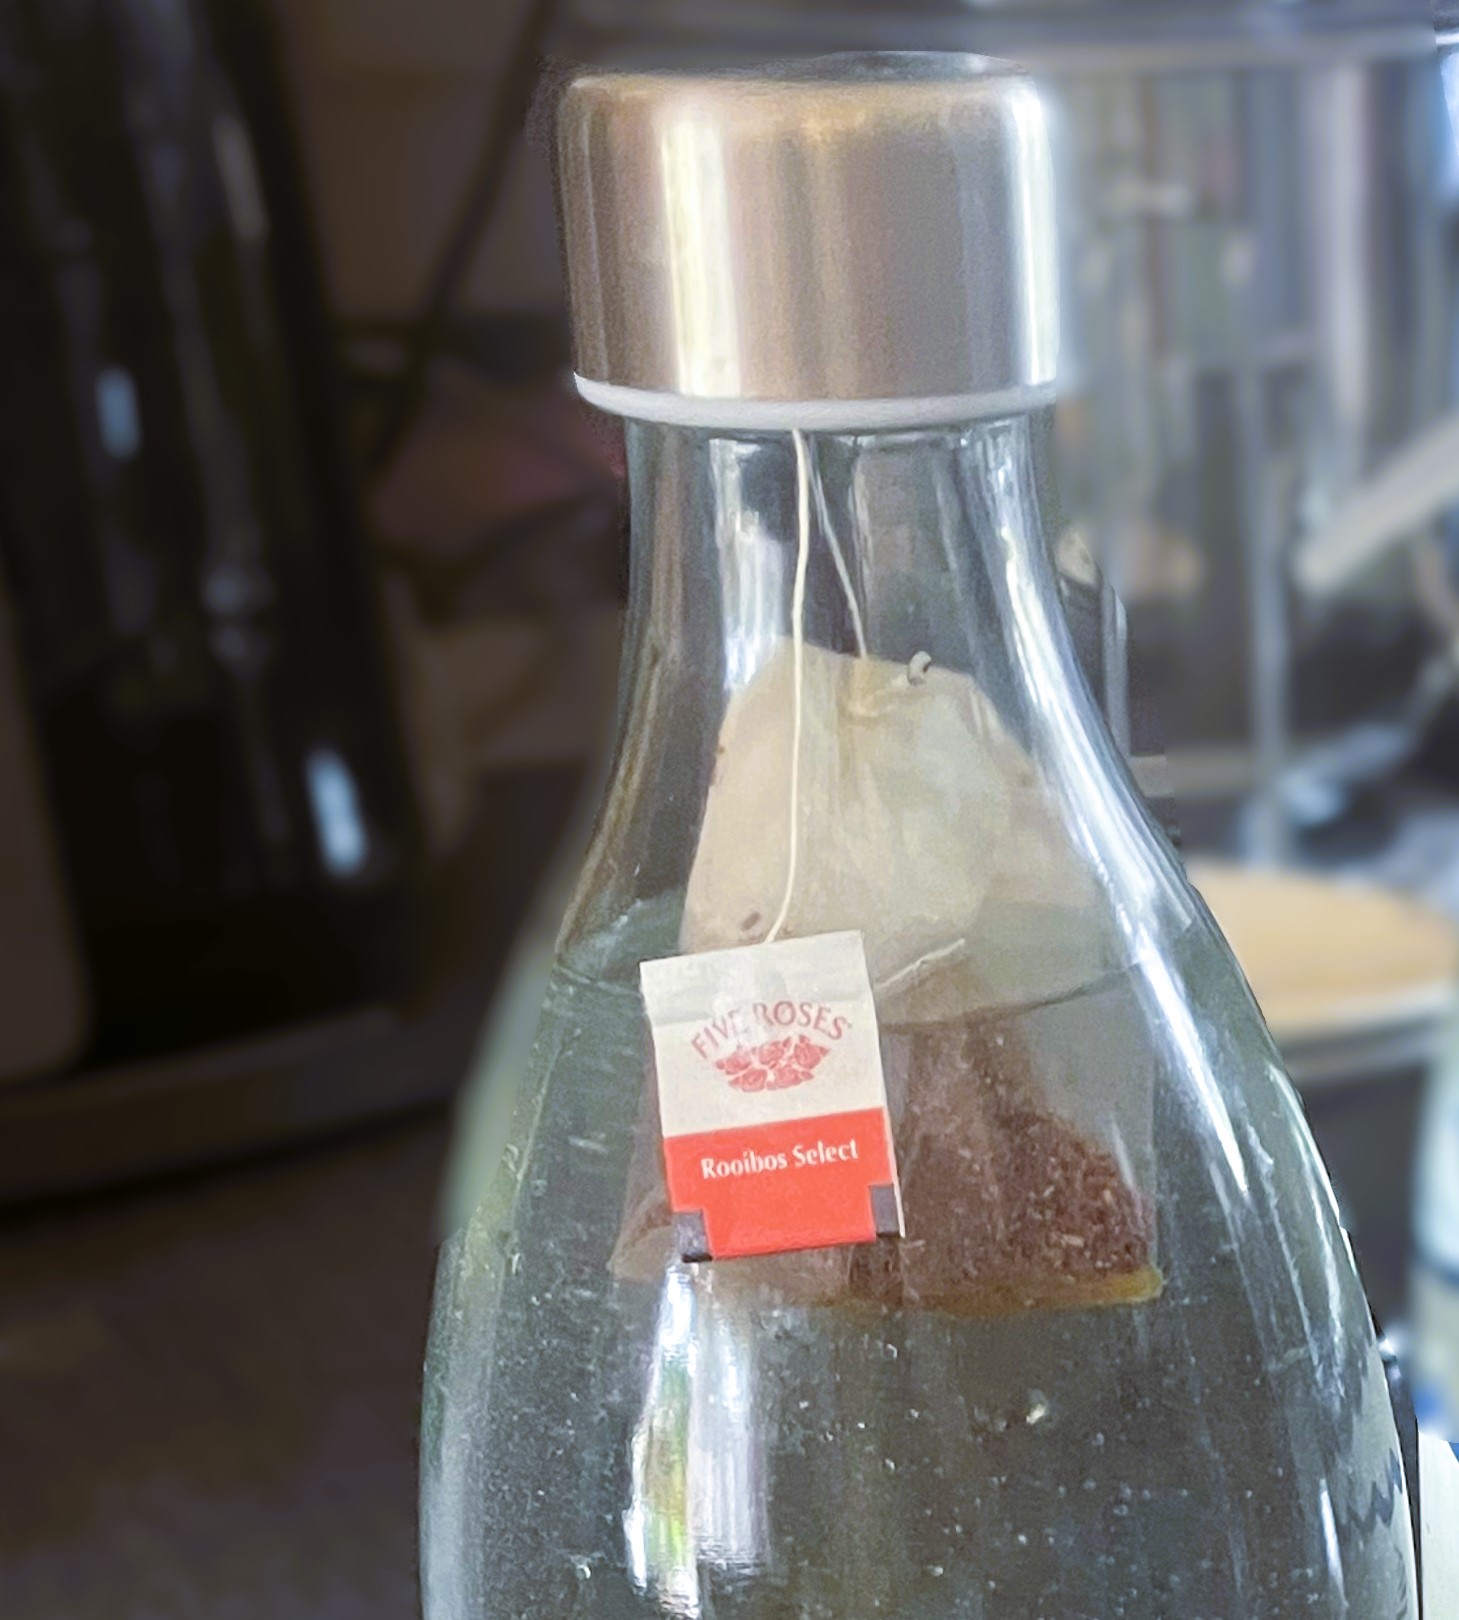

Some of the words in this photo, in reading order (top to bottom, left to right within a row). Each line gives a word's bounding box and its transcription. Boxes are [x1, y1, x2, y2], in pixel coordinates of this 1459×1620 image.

[690, 1007, 749, 1060] FIVE
[752, 999, 848, 1041] ROSES
[701, 1150, 787, 1180] Rooibos
[792, 1138, 859, 1167] Select
